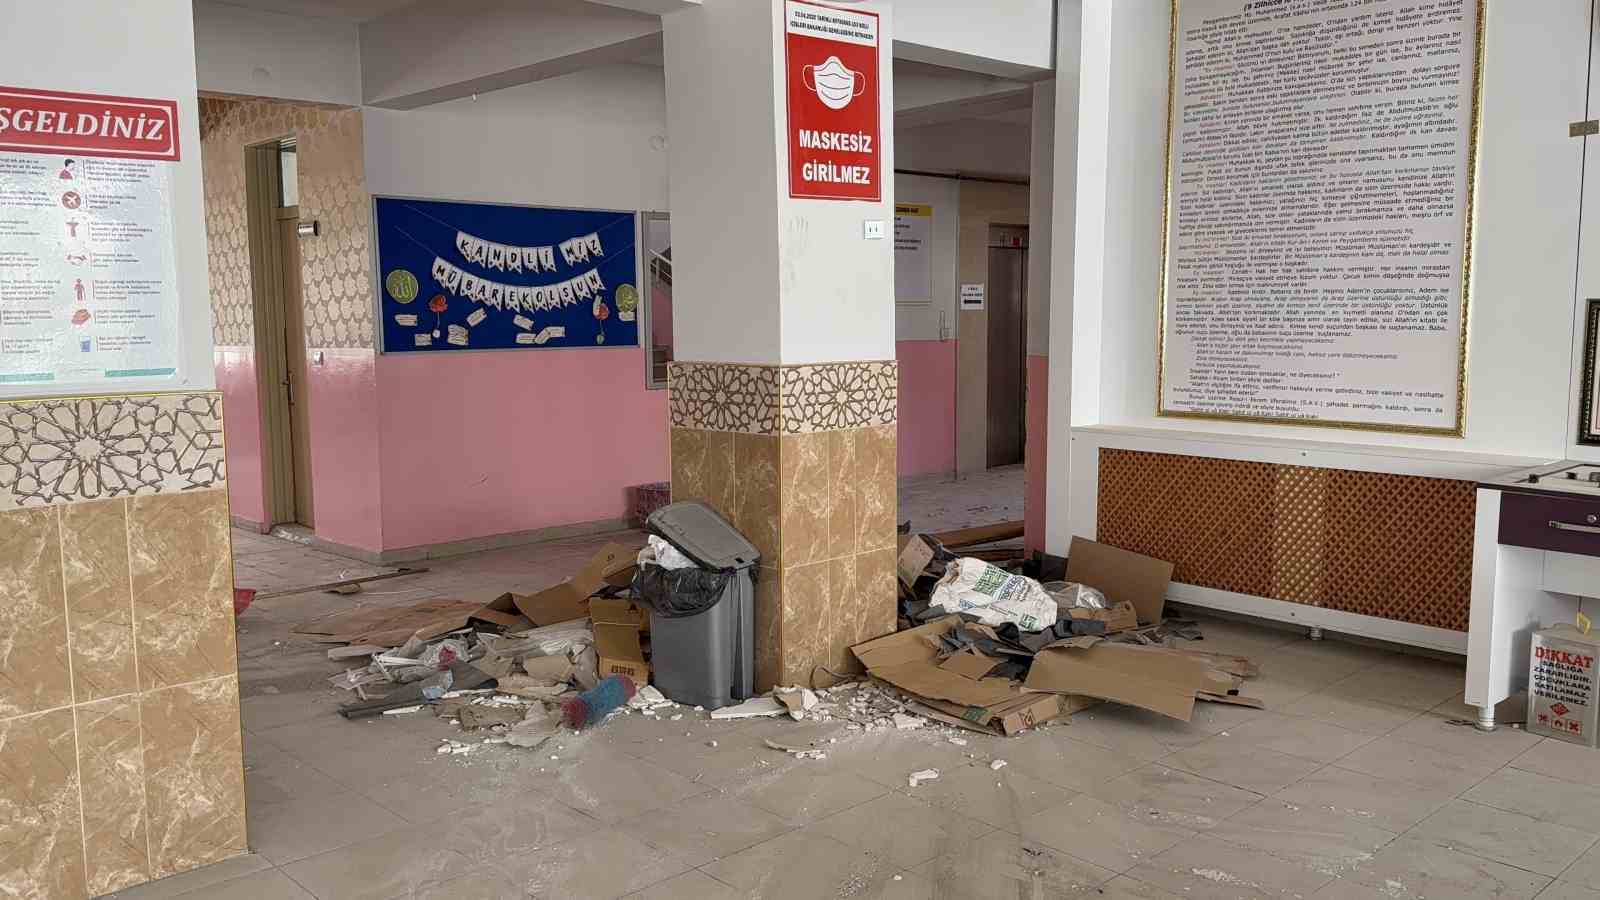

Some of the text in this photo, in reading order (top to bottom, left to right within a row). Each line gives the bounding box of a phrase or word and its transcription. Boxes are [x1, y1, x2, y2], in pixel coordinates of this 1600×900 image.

[799, 128, 872, 153] MASKESİZ
[802, 160, 870, 184] GİRİLMEZ
[1535, 646, 1594, 668] DİKKAT
